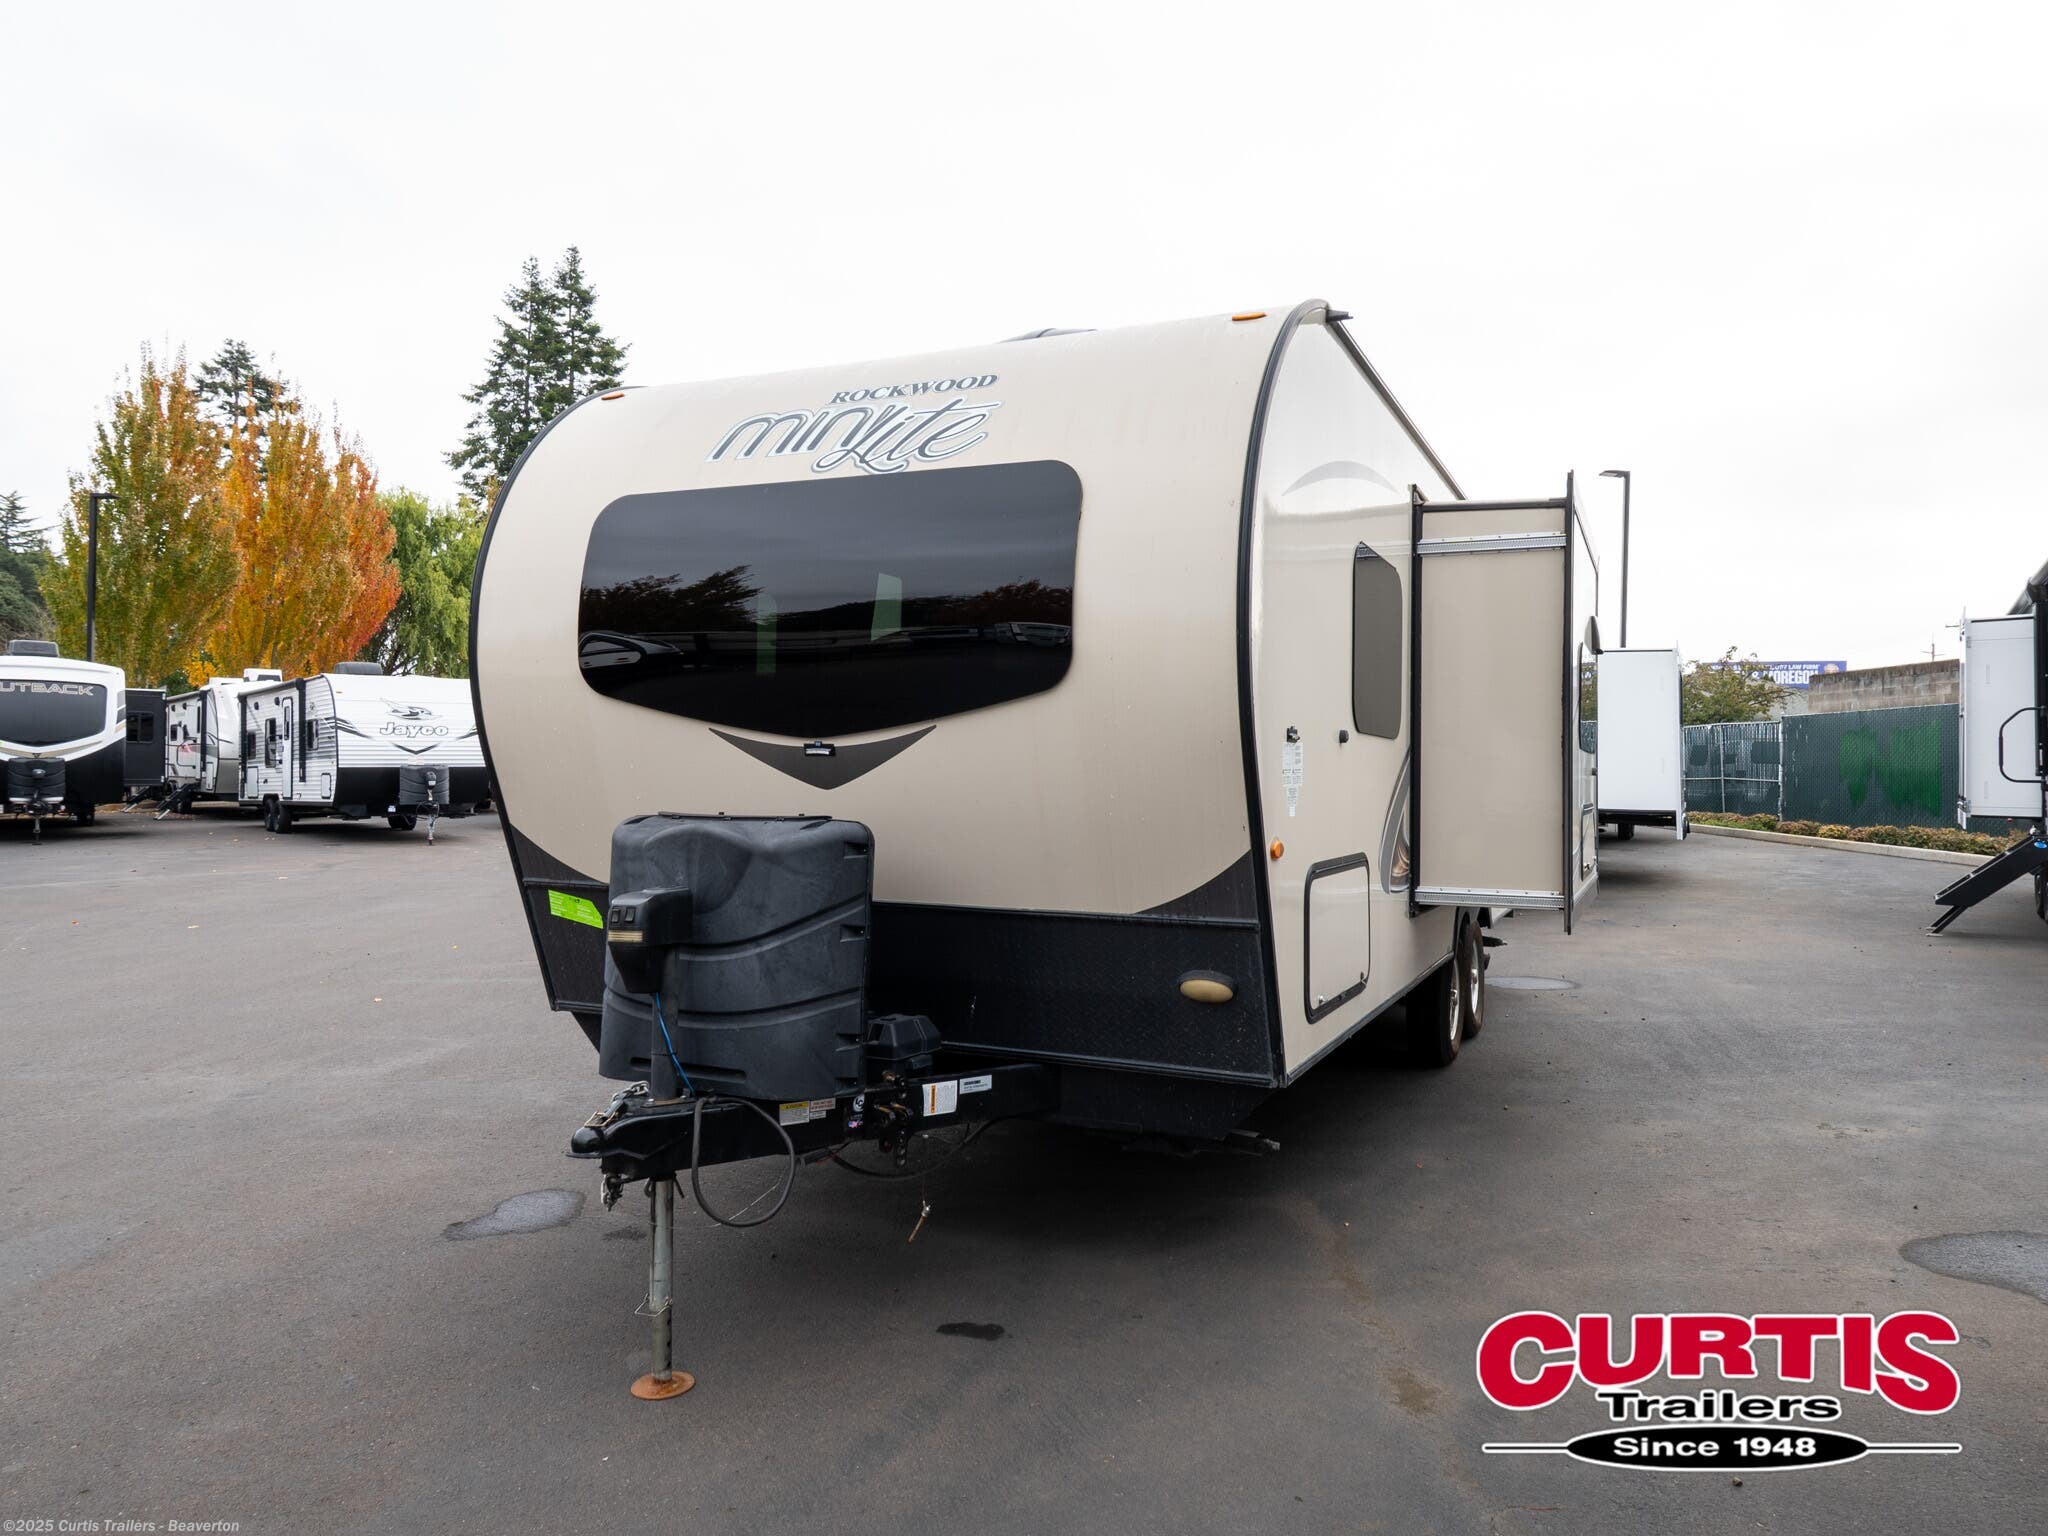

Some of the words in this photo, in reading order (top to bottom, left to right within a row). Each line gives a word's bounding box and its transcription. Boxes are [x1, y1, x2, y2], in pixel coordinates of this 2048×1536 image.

[830, 374, 998, 404] ROCKWOOD
[0, 681, 94, 696] UTBACK
[379, 722, 448, 738] Jayco
